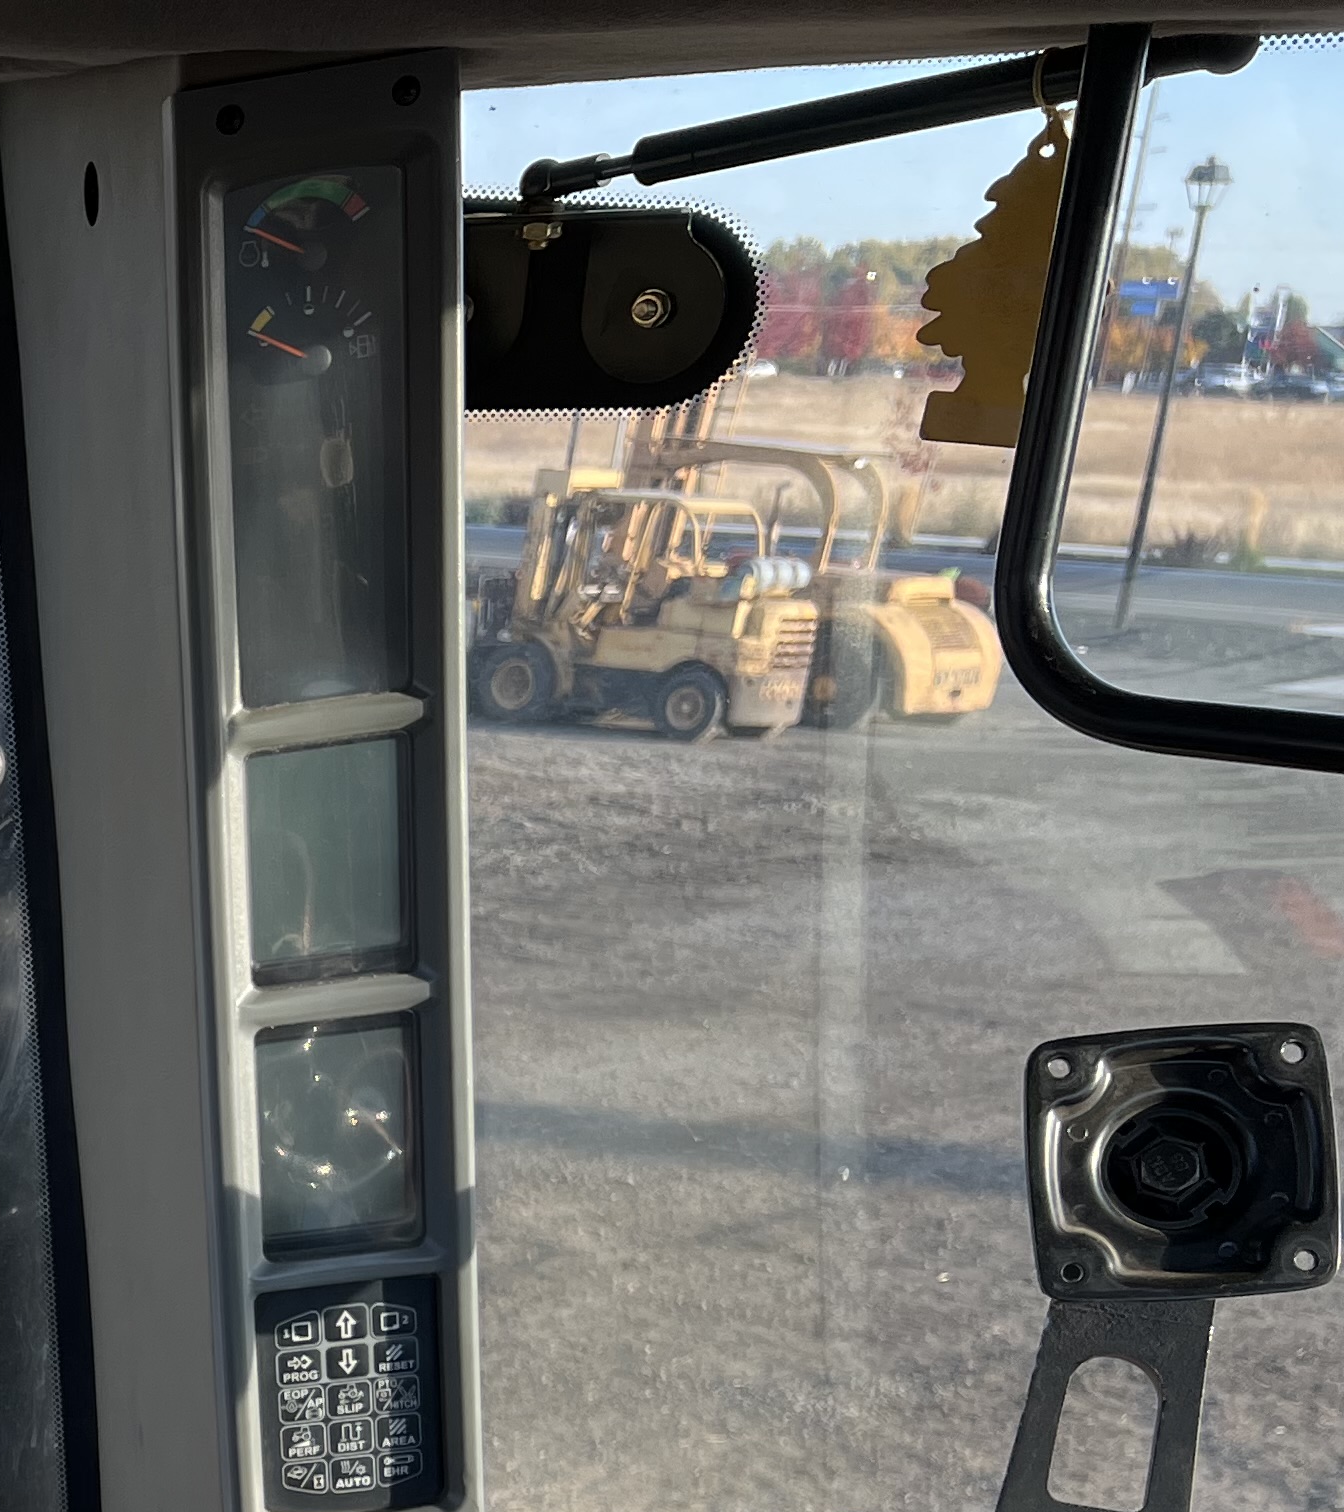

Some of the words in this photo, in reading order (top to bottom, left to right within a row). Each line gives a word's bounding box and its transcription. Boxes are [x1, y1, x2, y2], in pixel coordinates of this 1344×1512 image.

[378, 1360, 414, 1372] RESET
[283, 1371, 319, 1382] PROG
[377, 1379, 398, 1389] PTO
[284, 1389, 309, 1400] EOP
[337, 1403, 363, 1415] SLIP
[390, 1400, 417, 1410] HITCH
[338, 1441, 365, 1452] DIST
[382, 1436, 415, 1447] AREA
[288, 1446, 321, 1457] PERF
[384, 1465, 409, 1477] EHR
[336, 1476, 371, 1489] AUTO
